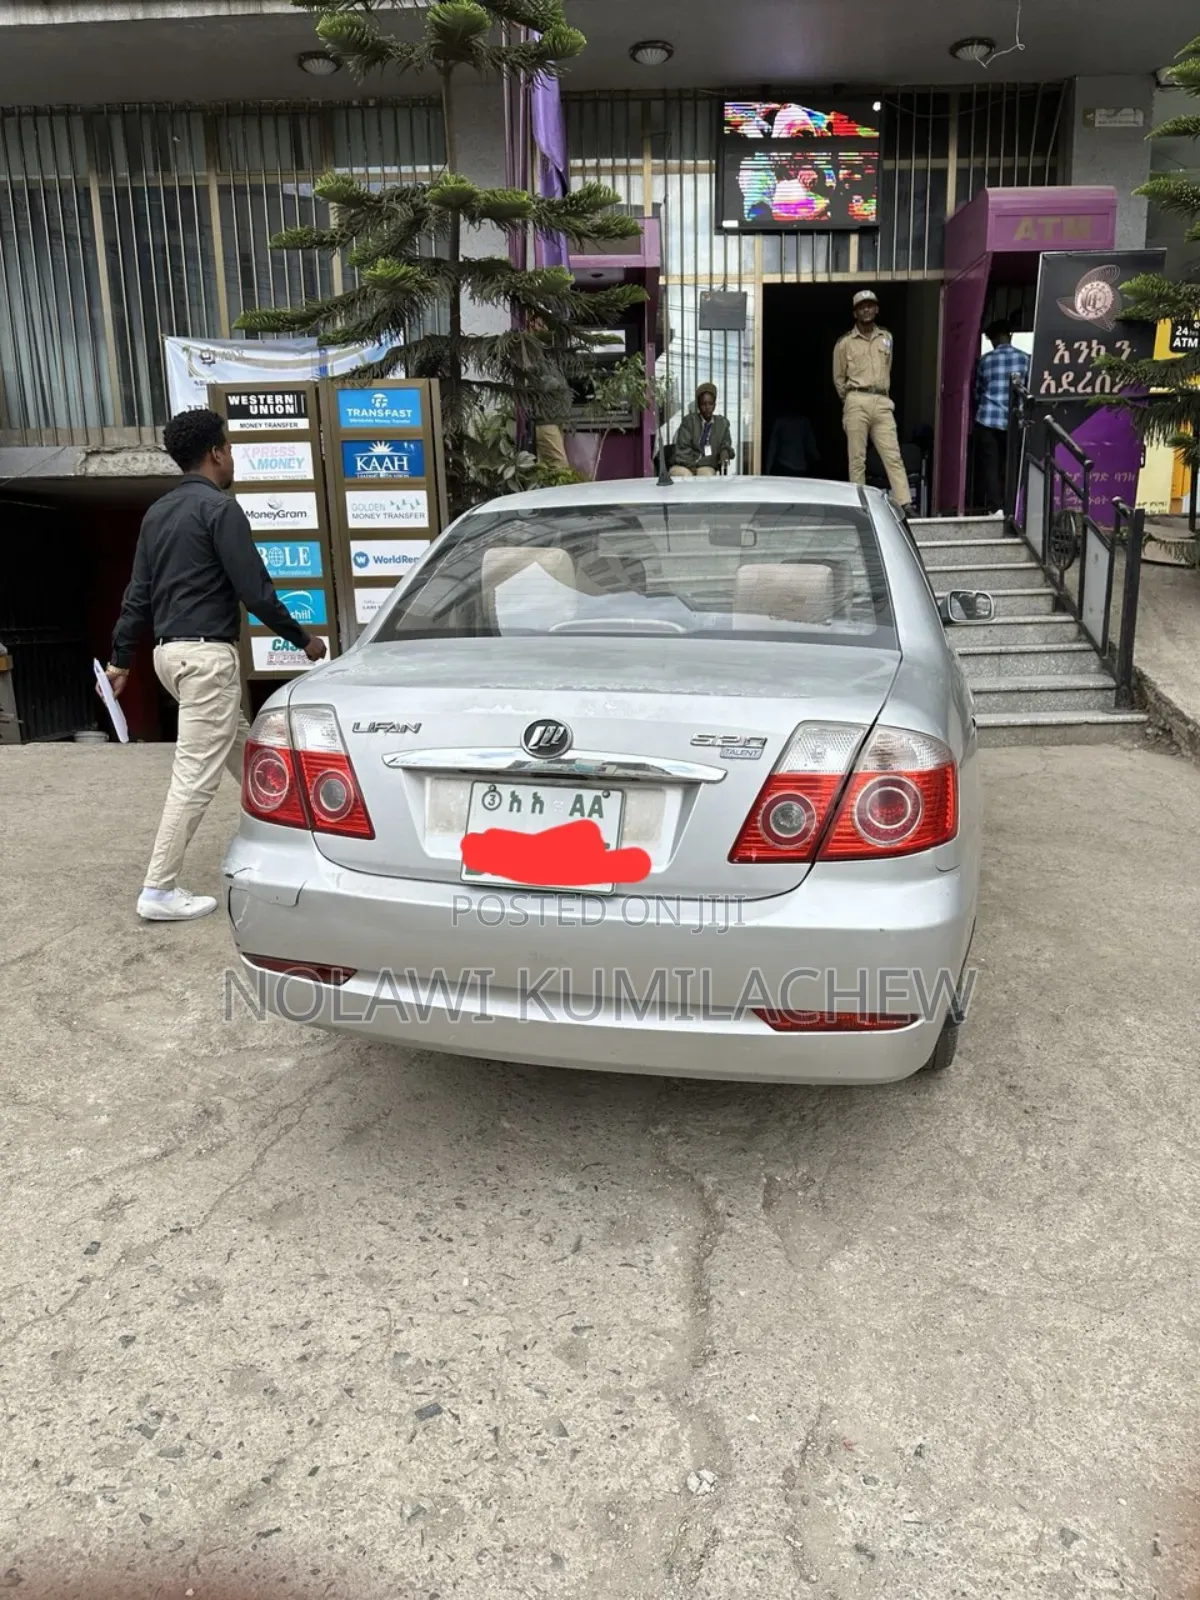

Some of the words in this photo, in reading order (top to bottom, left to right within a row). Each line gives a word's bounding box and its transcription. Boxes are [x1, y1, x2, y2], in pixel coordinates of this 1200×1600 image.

[1012, 216, 1092, 241] ATM
[1175, 325, 1189, 336] 24
[1172, 336, 1199, 348] ATM
[227, 394, 294, 406] WESTERN
[249, 404, 295, 415] UNION
[346, 408, 412, 418] TRANSFAST
[242, 446, 297, 460] XPRESS
[257, 457, 305, 470] MONEY
[355, 456, 410, 471] KAAH
[351, 503, 386, 512] GOLDEN
[245, 509, 307, 521] MoneyGram
[351, 512, 381, 520] MONEY
[383, 512, 426, 520] TRANSFER
[373, 555, 420, 564] WorldRe
[272, 638, 302, 651] CAS
[724, 748, 760, 757] TALENT
[568, 793, 605, 819] AA
